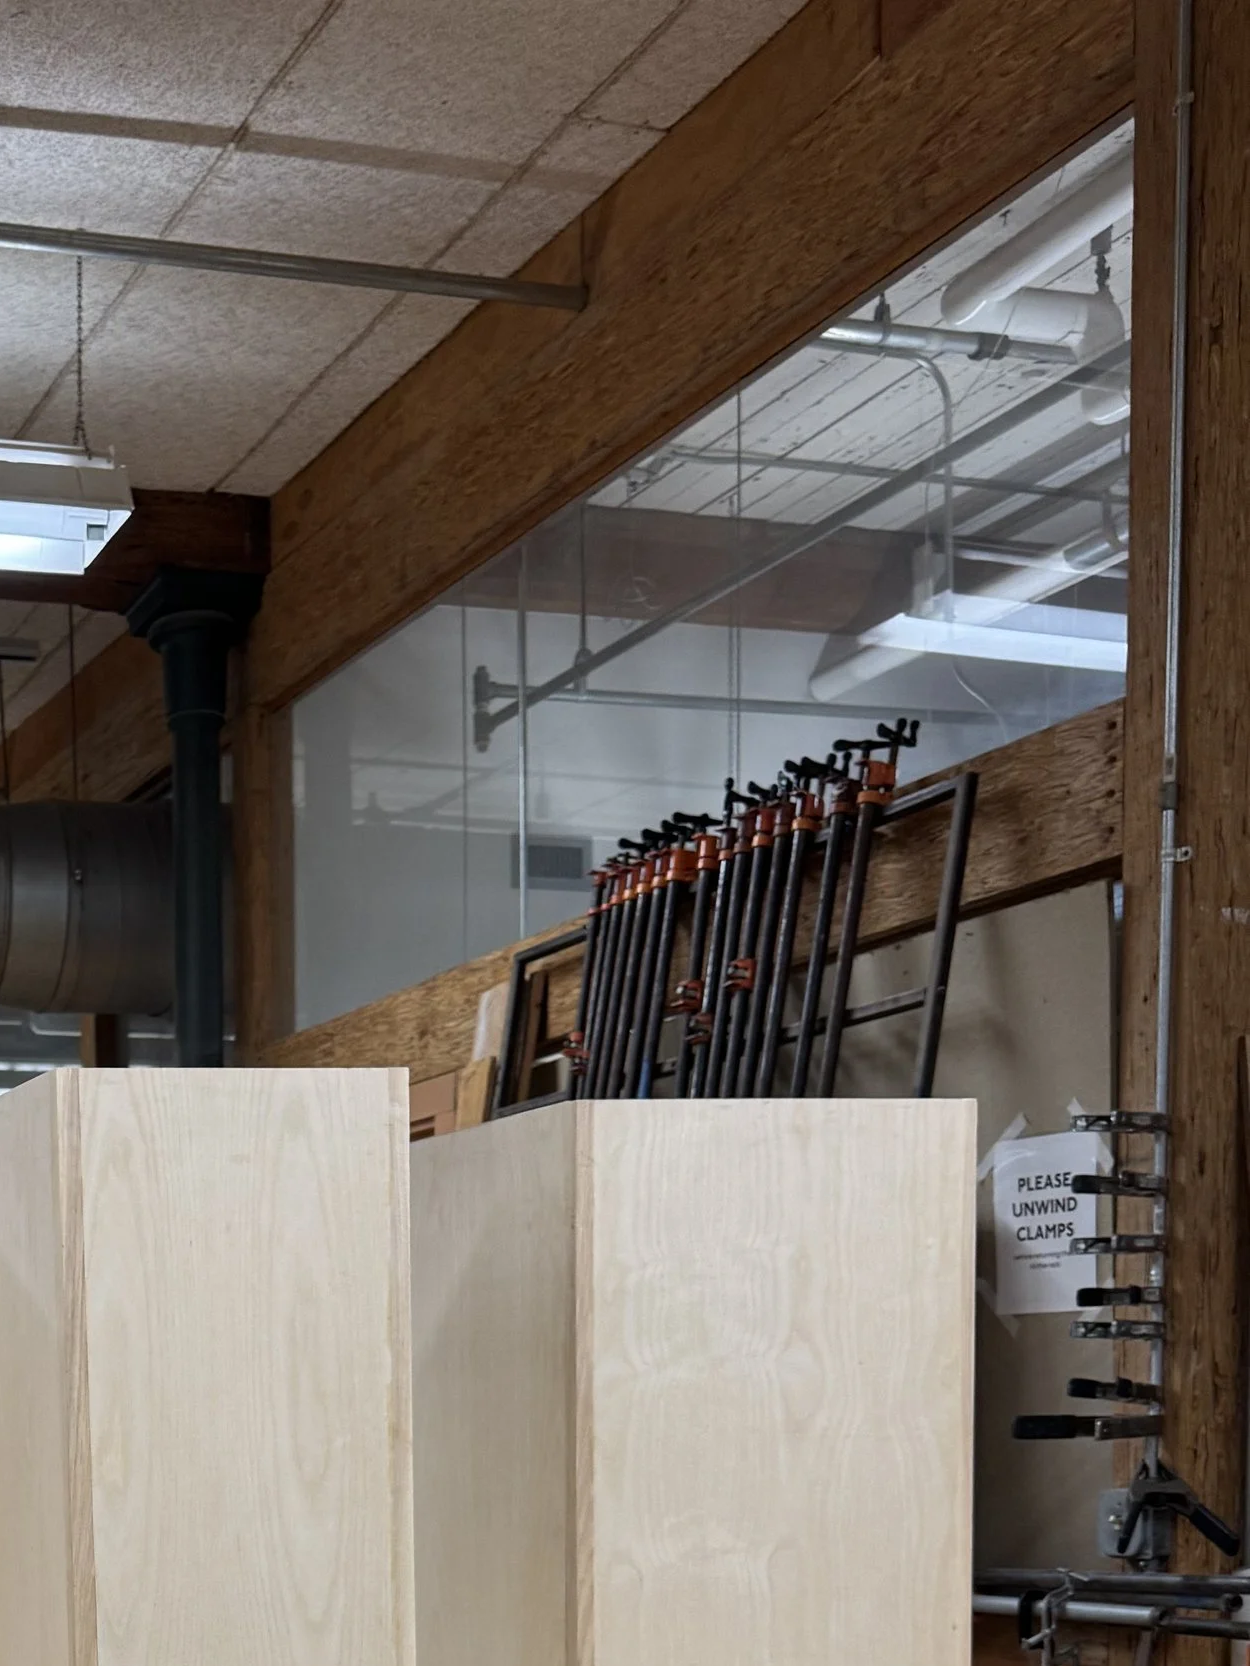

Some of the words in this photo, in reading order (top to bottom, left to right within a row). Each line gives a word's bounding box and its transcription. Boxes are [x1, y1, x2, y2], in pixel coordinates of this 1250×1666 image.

[1017, 1172, 1072, 1193] PLEASE
[1012, 1197, 1078, 1217] UNWIND
[1016, 1222, 1075, 1242] CLAMPS
